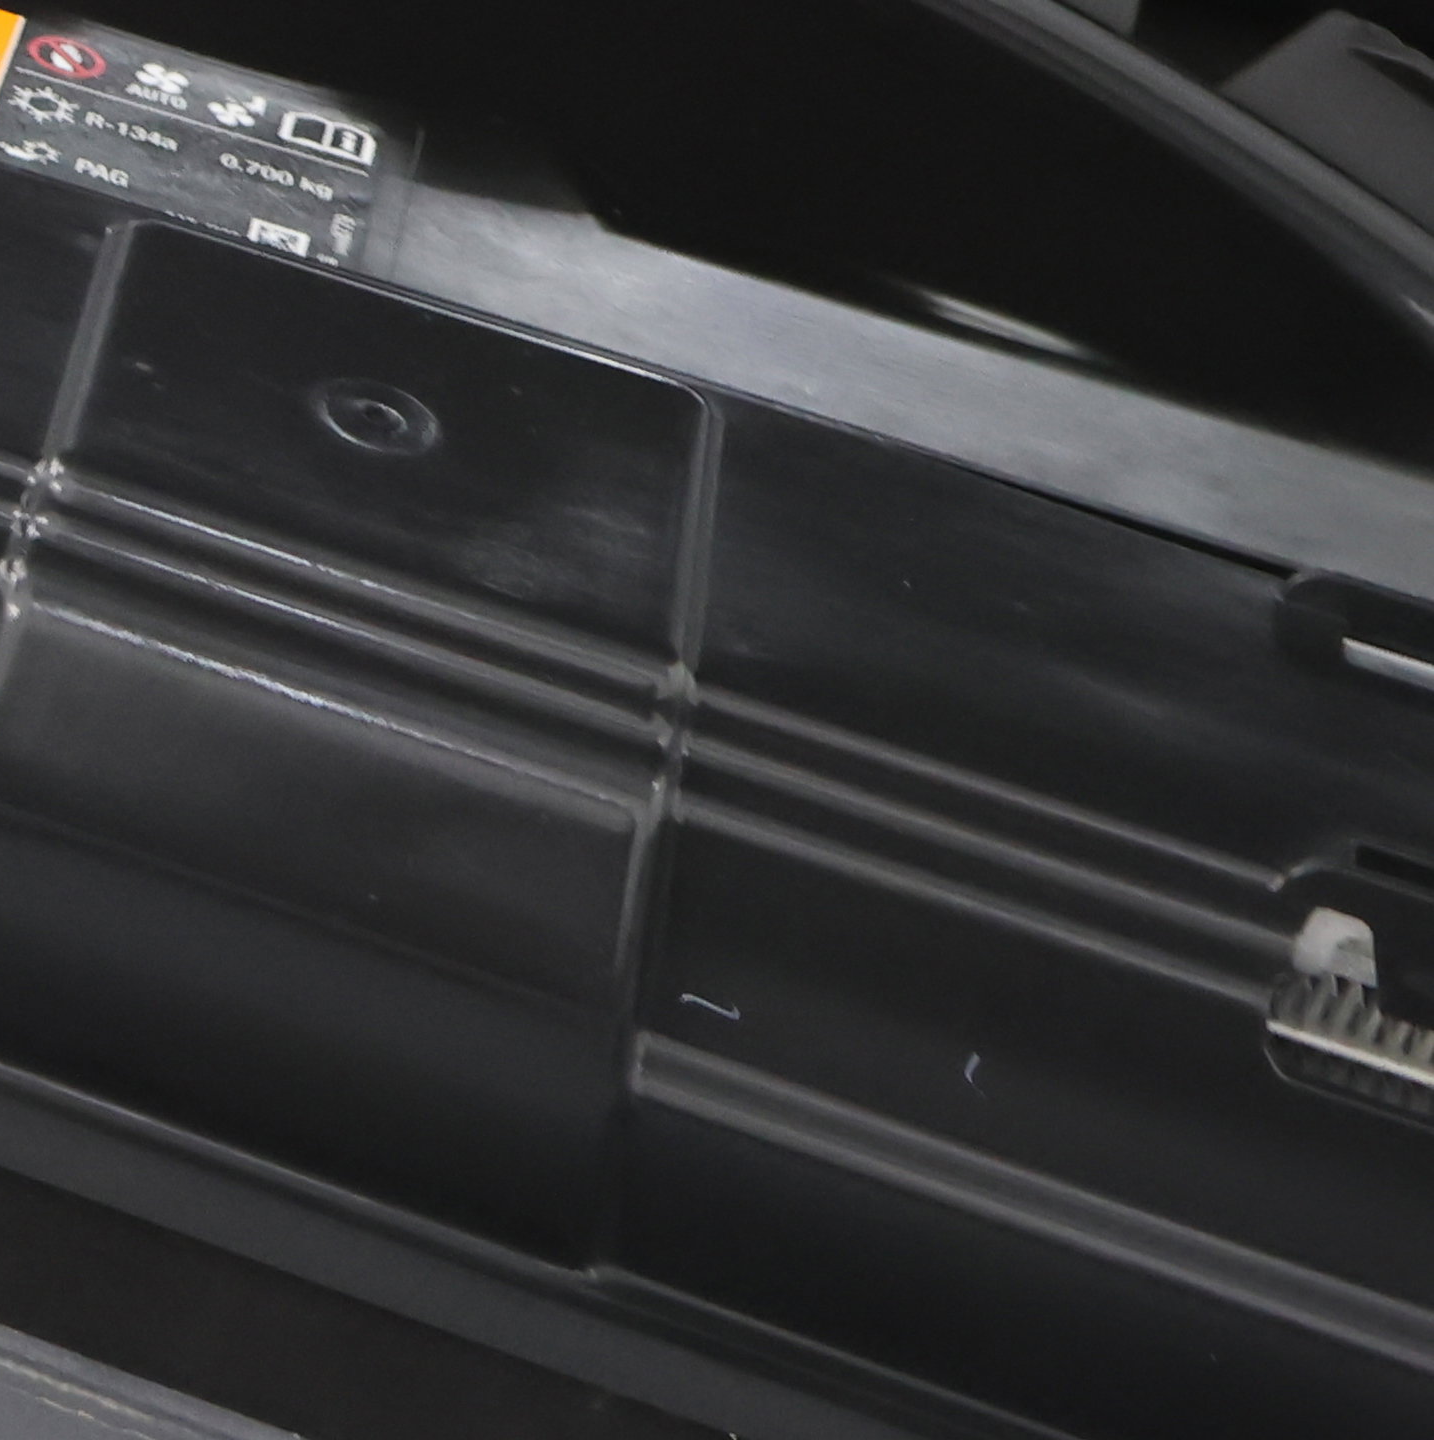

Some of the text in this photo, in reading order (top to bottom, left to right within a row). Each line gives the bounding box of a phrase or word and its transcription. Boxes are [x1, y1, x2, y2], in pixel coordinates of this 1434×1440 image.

[124, 82, 188, 111] AUTO
[84, 110, 179, 153] R-134a
[219, 152, 295, 187] 0.700
[73, 156, 130, 189] PAG
